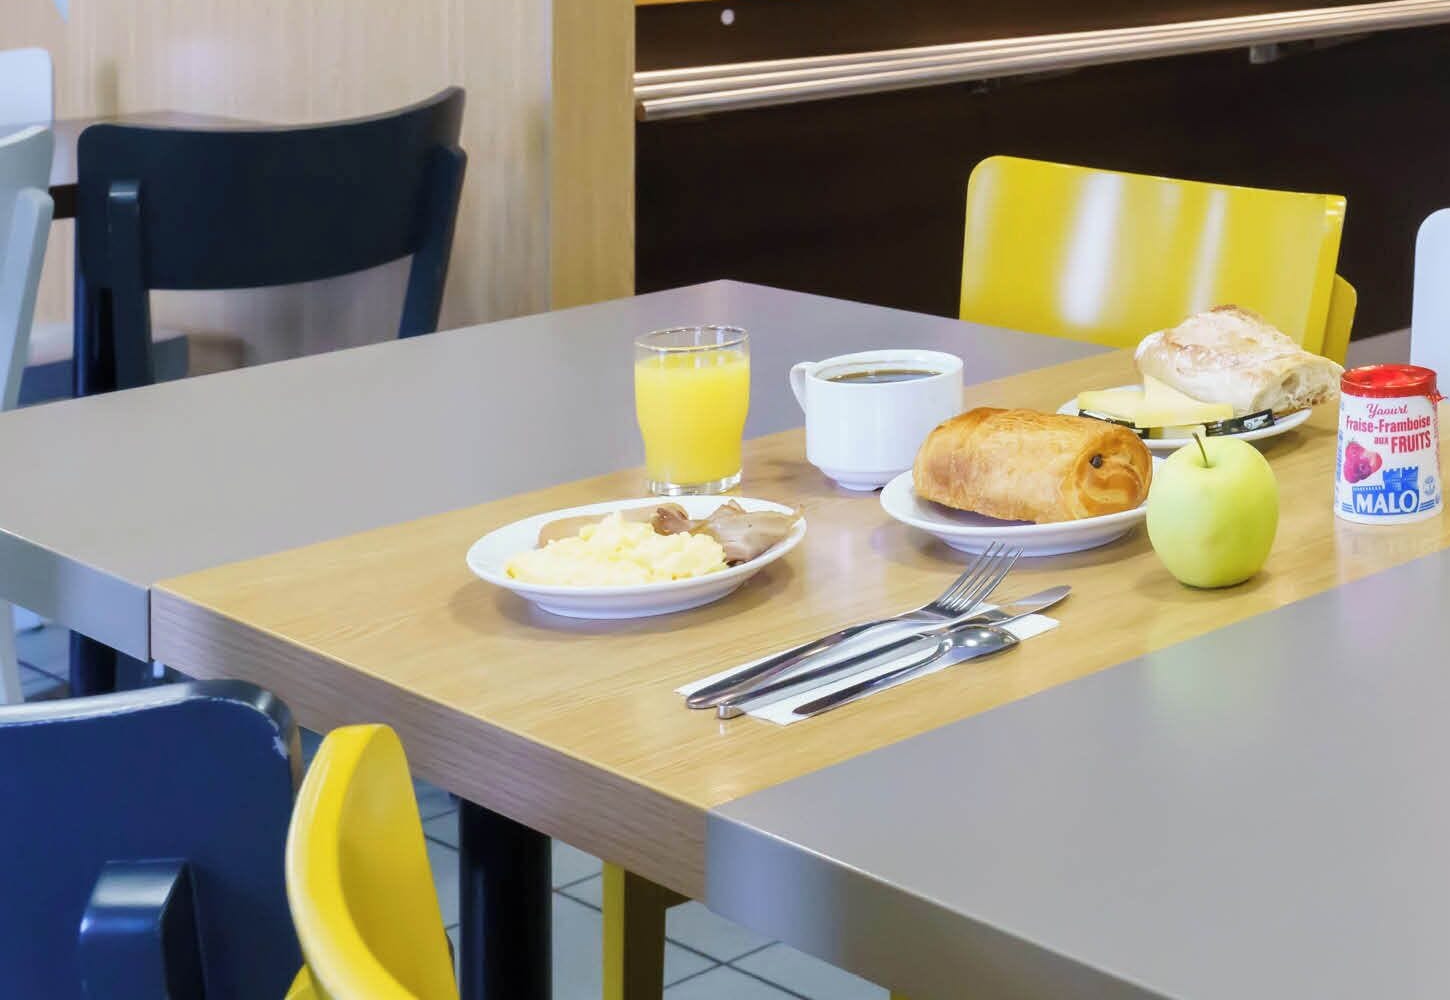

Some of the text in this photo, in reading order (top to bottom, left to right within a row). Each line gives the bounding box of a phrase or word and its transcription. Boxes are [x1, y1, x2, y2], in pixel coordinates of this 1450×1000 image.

[1366, 403, 1408, 418] Yaourt
[1346, 415, 1431, 433] Fraise-Framboise
[1391, 430, 1431, 454] FRUITS
[1356, 489, 1418, 513] MALO
